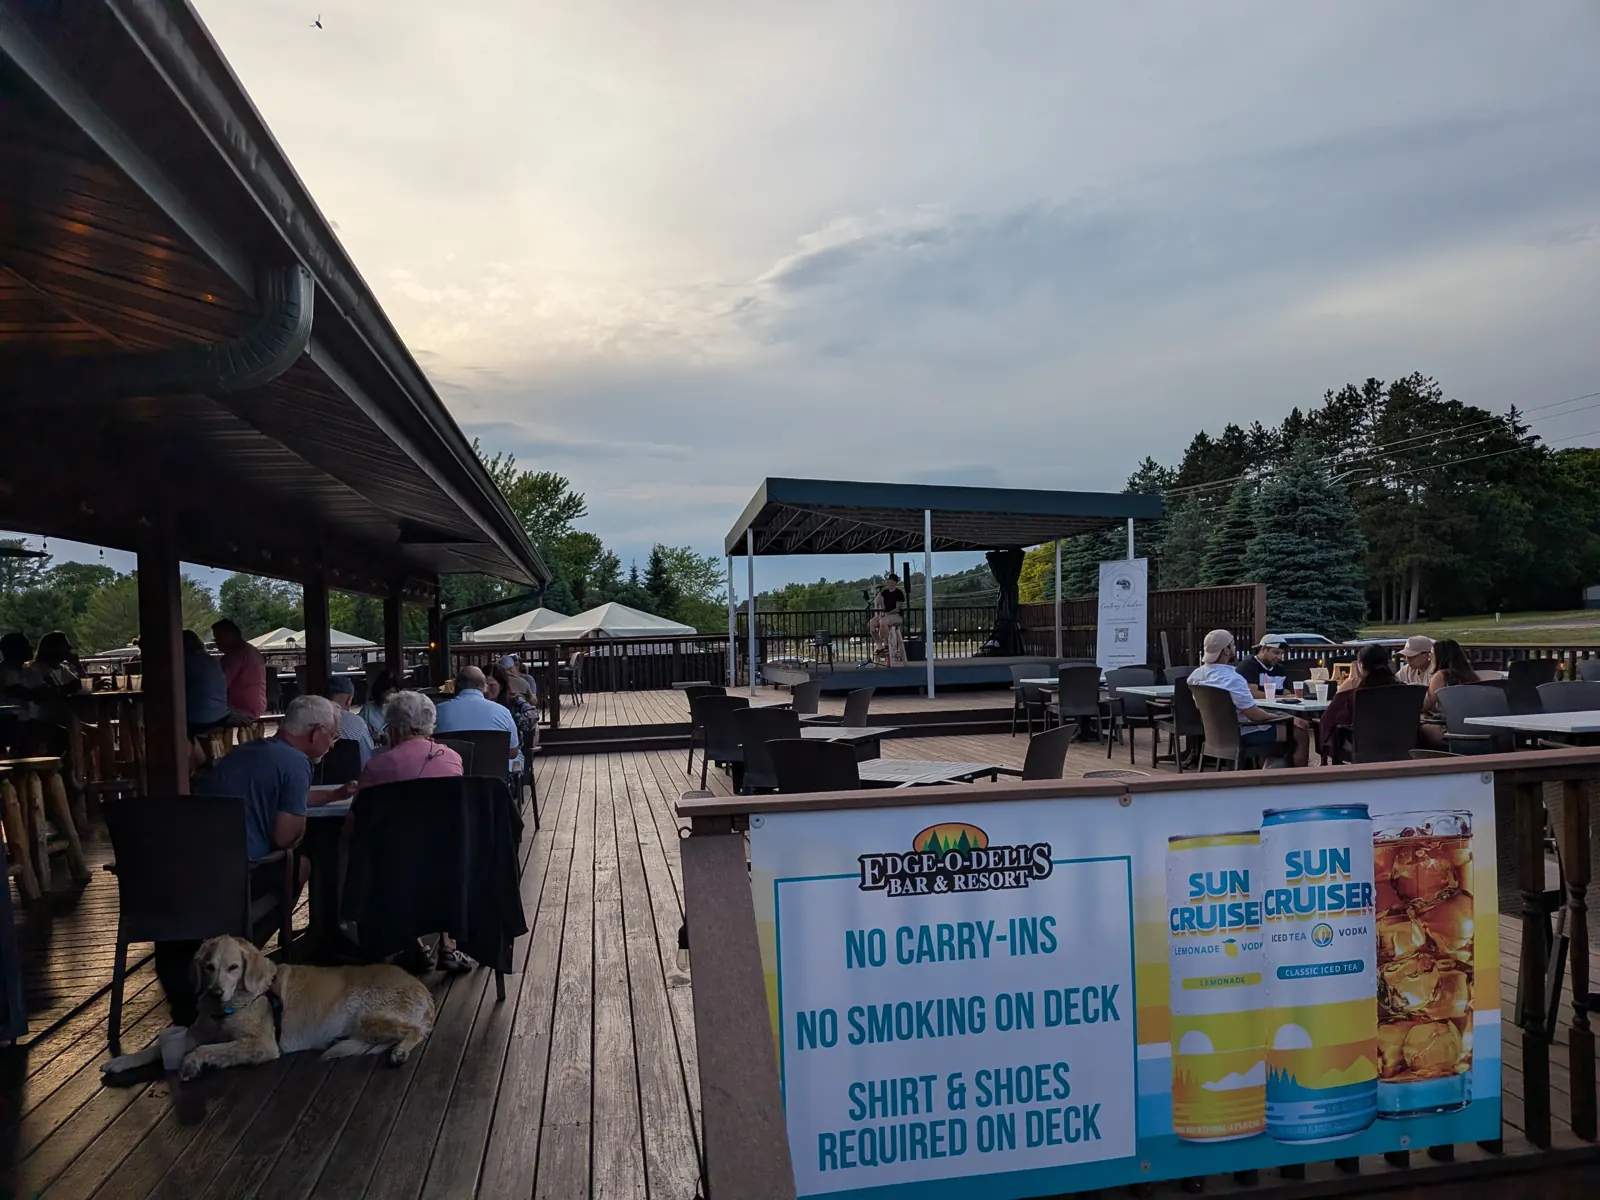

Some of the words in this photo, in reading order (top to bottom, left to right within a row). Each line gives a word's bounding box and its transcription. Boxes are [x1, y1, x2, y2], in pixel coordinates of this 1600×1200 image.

[861, 845, 1051, 888] EDGE-O-DELLS
[1285, 847, 1351, 879] SUN
[889, 876, 928, 895] BAR
[934, 875, 948, 892] &
[953, 869, 1029, 891] RESORT
[1189, 870, 1249, 897] SUN
[1264, 882, 1373, 916] CRUISER
[1170, 902, 1262, 931] CRUISE
[846, 928, 886, 969] NO
[896, 916, 1057, 966] CARRY-INS
[1175, 945, 1220, 955] LEMONADE
[1241, 942, 1263, 951] VOD
[1272, 934, 1288, 942] ICED
[1289, 933, 1306, 941] TEA
[1339, 927, 1367, 937] VODKA
[1200, 976, 1245, 986] LEMONADE
[1285, 968, 1318, 977] CLASSIC
[1343, 963, 1358, 971] TEA
[797, 1009, 838, 1050] NO
[848, 997, 986, 1046] SMOKING
[995, 991, 1034, 1032] ON
[1044, 984, 1121, 1026] DECK
[848, 1074, 937, 1121] SHIRT
[947, 1072, 967, 1110] &
[975, 1062, 1070, 1109] SHOES
[818, 1117, 967, 1171] REQUIRED
[976, 1113, 1016, 1154] ON
[1025, 1103, 1102, 1148] DECK
